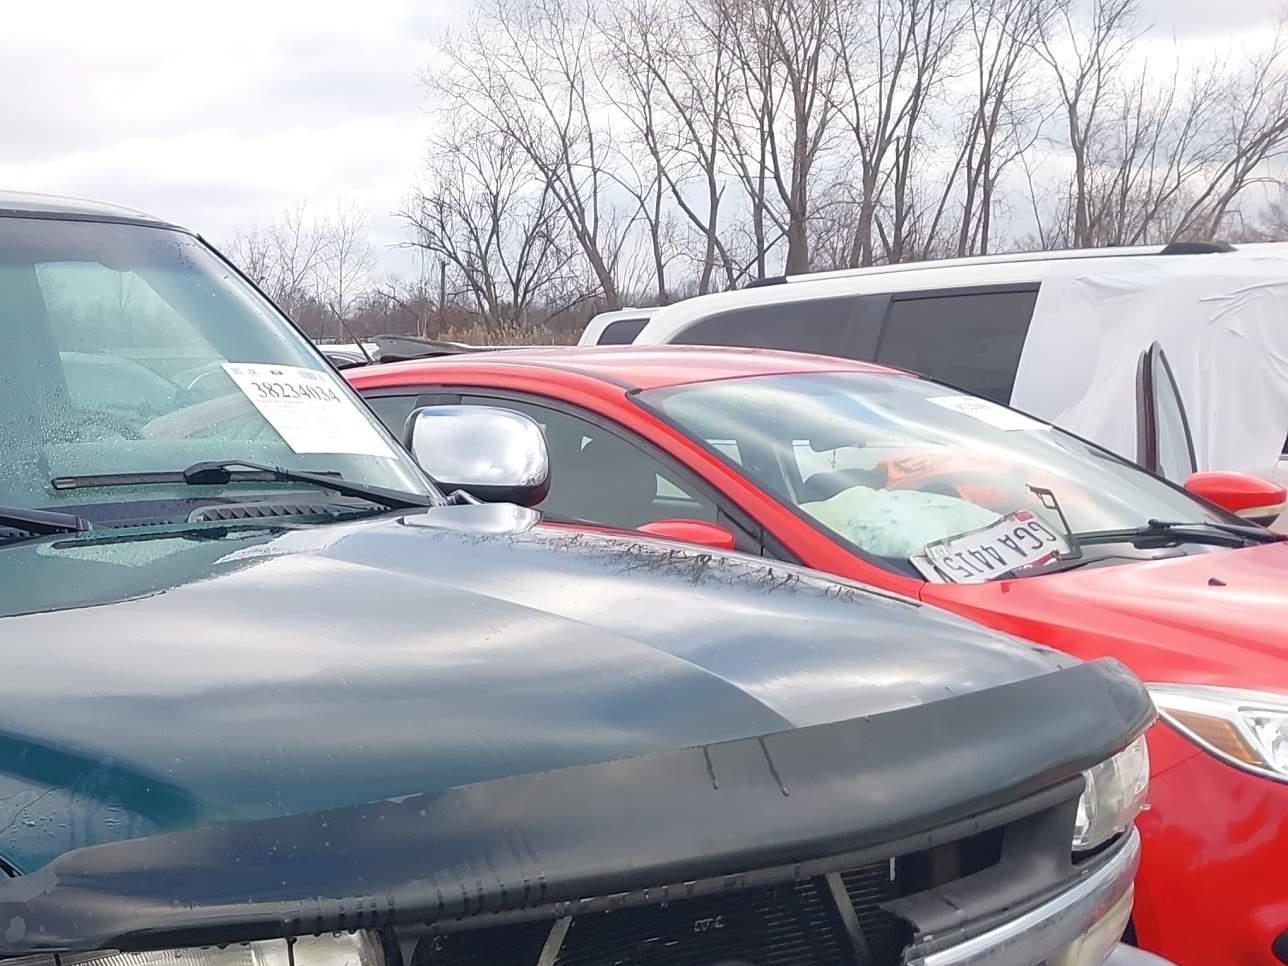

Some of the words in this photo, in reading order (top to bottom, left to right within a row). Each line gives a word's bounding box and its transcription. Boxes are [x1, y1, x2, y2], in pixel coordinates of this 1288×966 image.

[250, 381, 342, 404] 38234034
[997, 521, 1057, 558] GGA
[943, 544, 1007, 578] 4415
